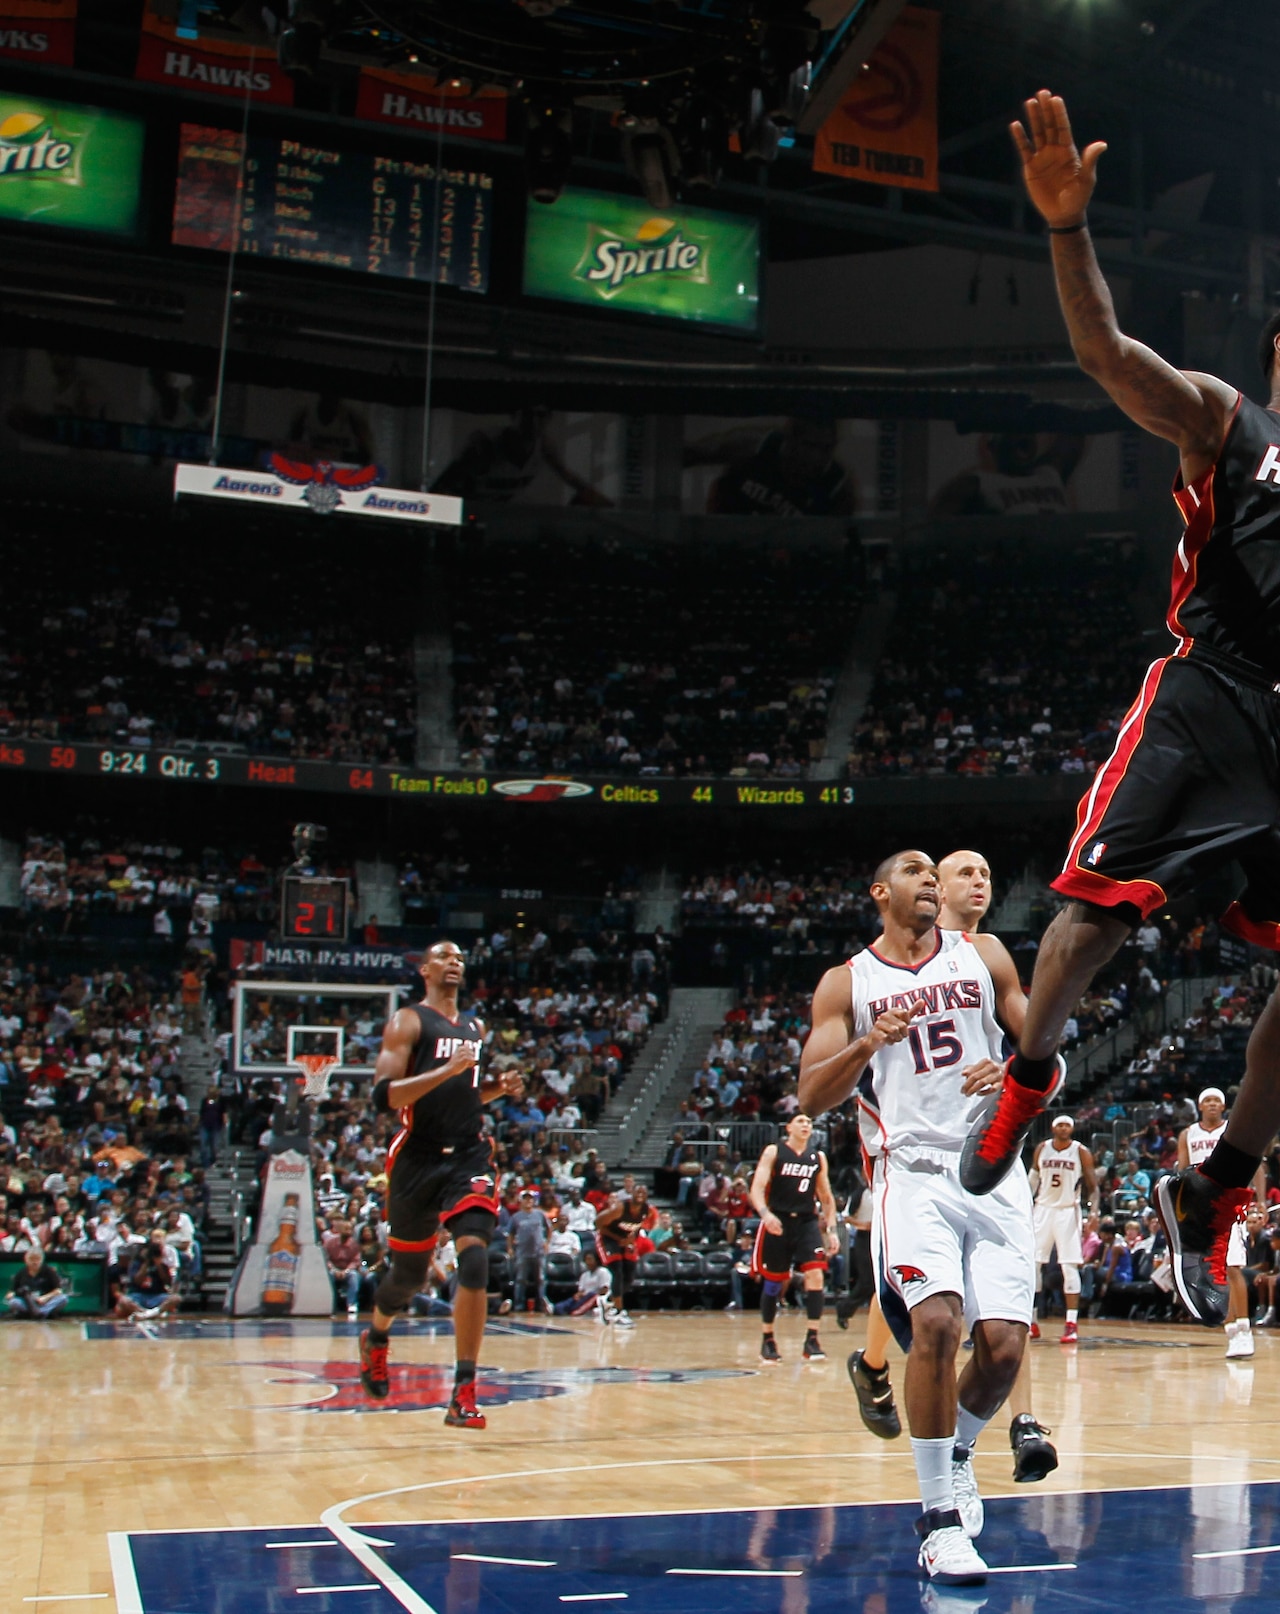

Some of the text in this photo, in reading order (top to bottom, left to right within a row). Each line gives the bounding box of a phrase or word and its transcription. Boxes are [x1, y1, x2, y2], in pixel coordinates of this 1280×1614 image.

[163, 51, 271, 91] HAWKS
[382, 93, 483, 128] HAWKS
[586, 235, 700, 286] Sprite
[213, 476, 283, 497] Aaron's
[363, 494, 430, 515] Aaron's
[0, 743, 76, 768] ks 50
[100, 751, 220, 779] 9:24 Qtr. 3
[248, 761, 374, 789] Heat 64
[389, 773, 430, 792] Team
[601, 784, 713, 802] Celtics 44
[737, 786, 804, 804] Wizards
[296, 902, 334, 933] 21
[354, 952, 403, 969] MVPs
[868, 980, 981, 1021] HAWKS
[435, 1037, 482, 1061] HET
[908, 1019, 963, 1075] 15
[471, 1064, 480, 1088] 1
[781, 1162, 818, 1178] HEAT
[1051, 1174, 1061, 1187] 5
[798, 1178, 810, 1192] 0
